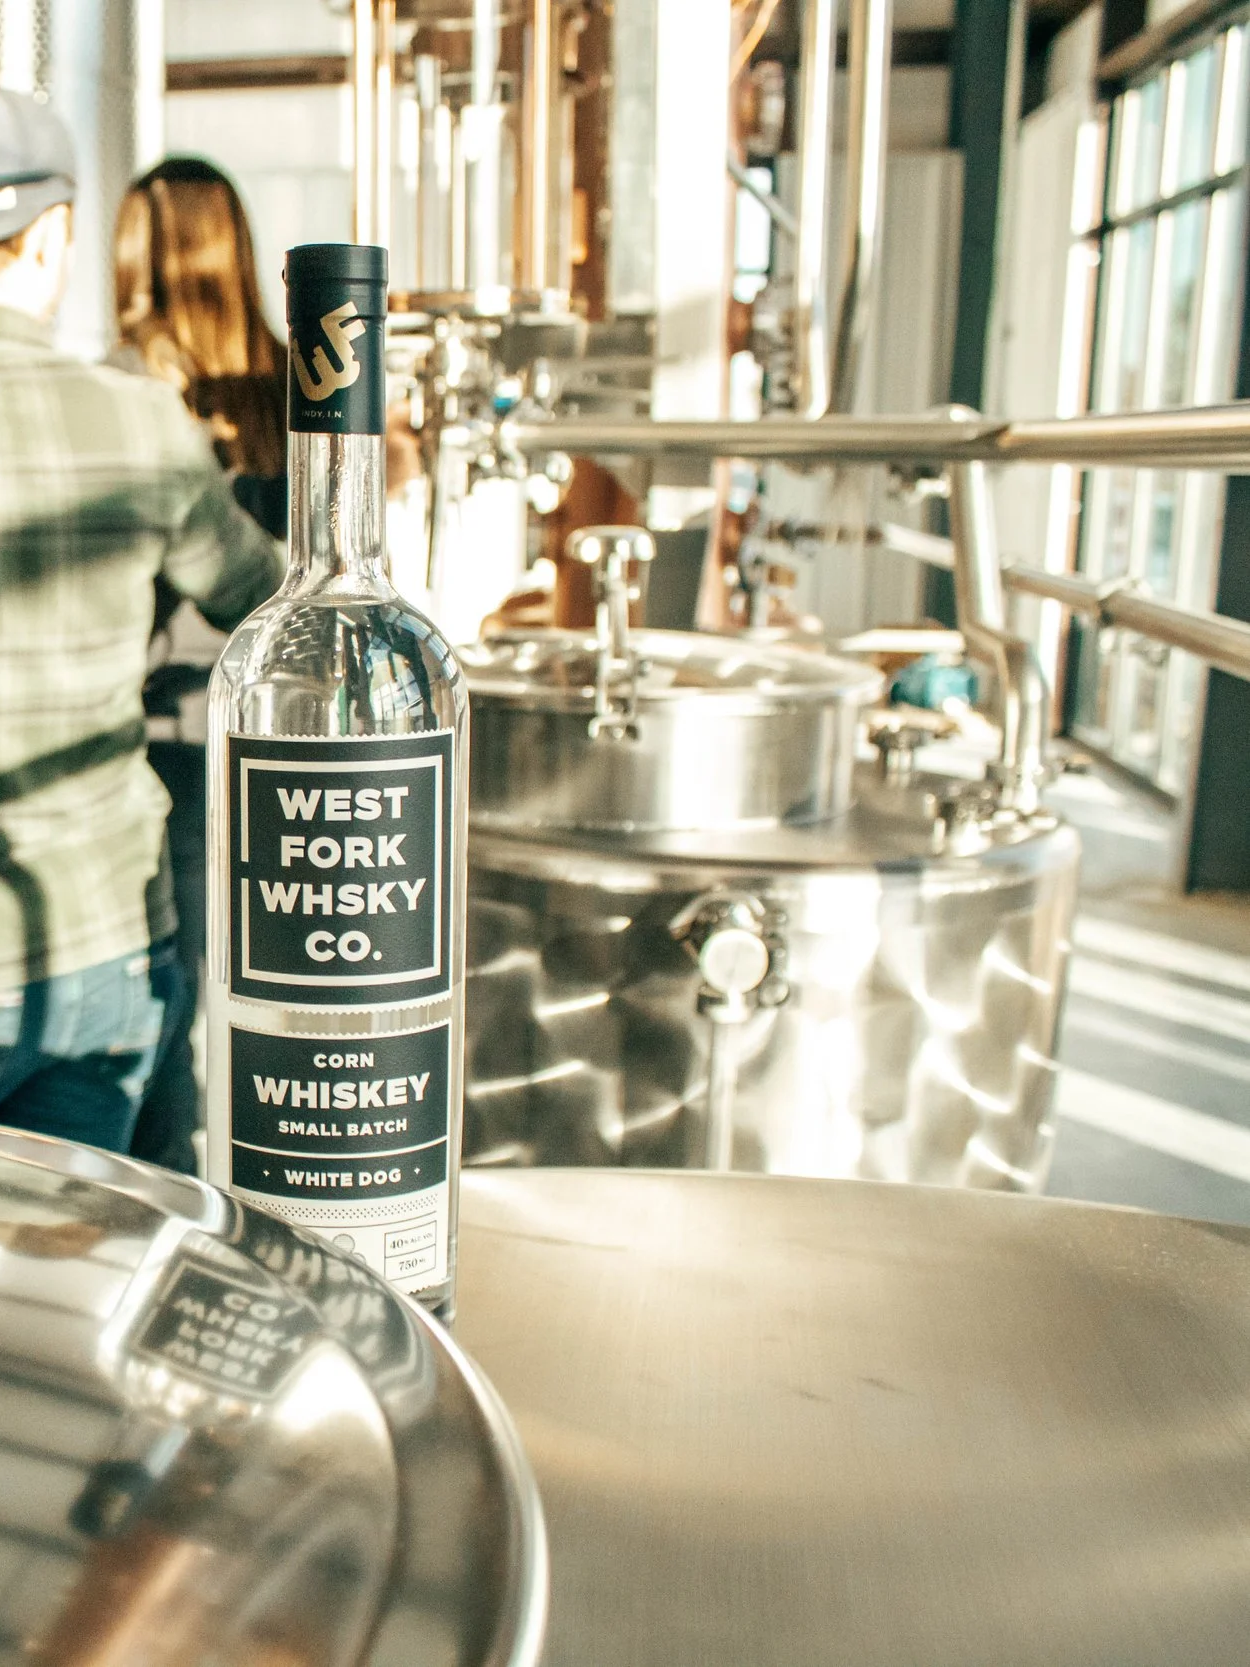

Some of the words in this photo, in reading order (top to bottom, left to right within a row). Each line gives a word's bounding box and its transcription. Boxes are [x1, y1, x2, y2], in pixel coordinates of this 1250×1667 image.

[276, 786, 409, 822] WEST
[280, 833, 407, 869] FORK
[258, 878, 427, 916] WHSKY
[305, 930, 383, 963] CO.
[313, 1052, 374, 1069] CORN
[252, 1071, 431, 1110] WHISKEY
[278, 1119, 343, 1137] SMALL
[346, 1117, 408, 1137] BATCH
[283, 1169, 354, 1187] WHITE
[358, 1167, 403, 1187] DOG
